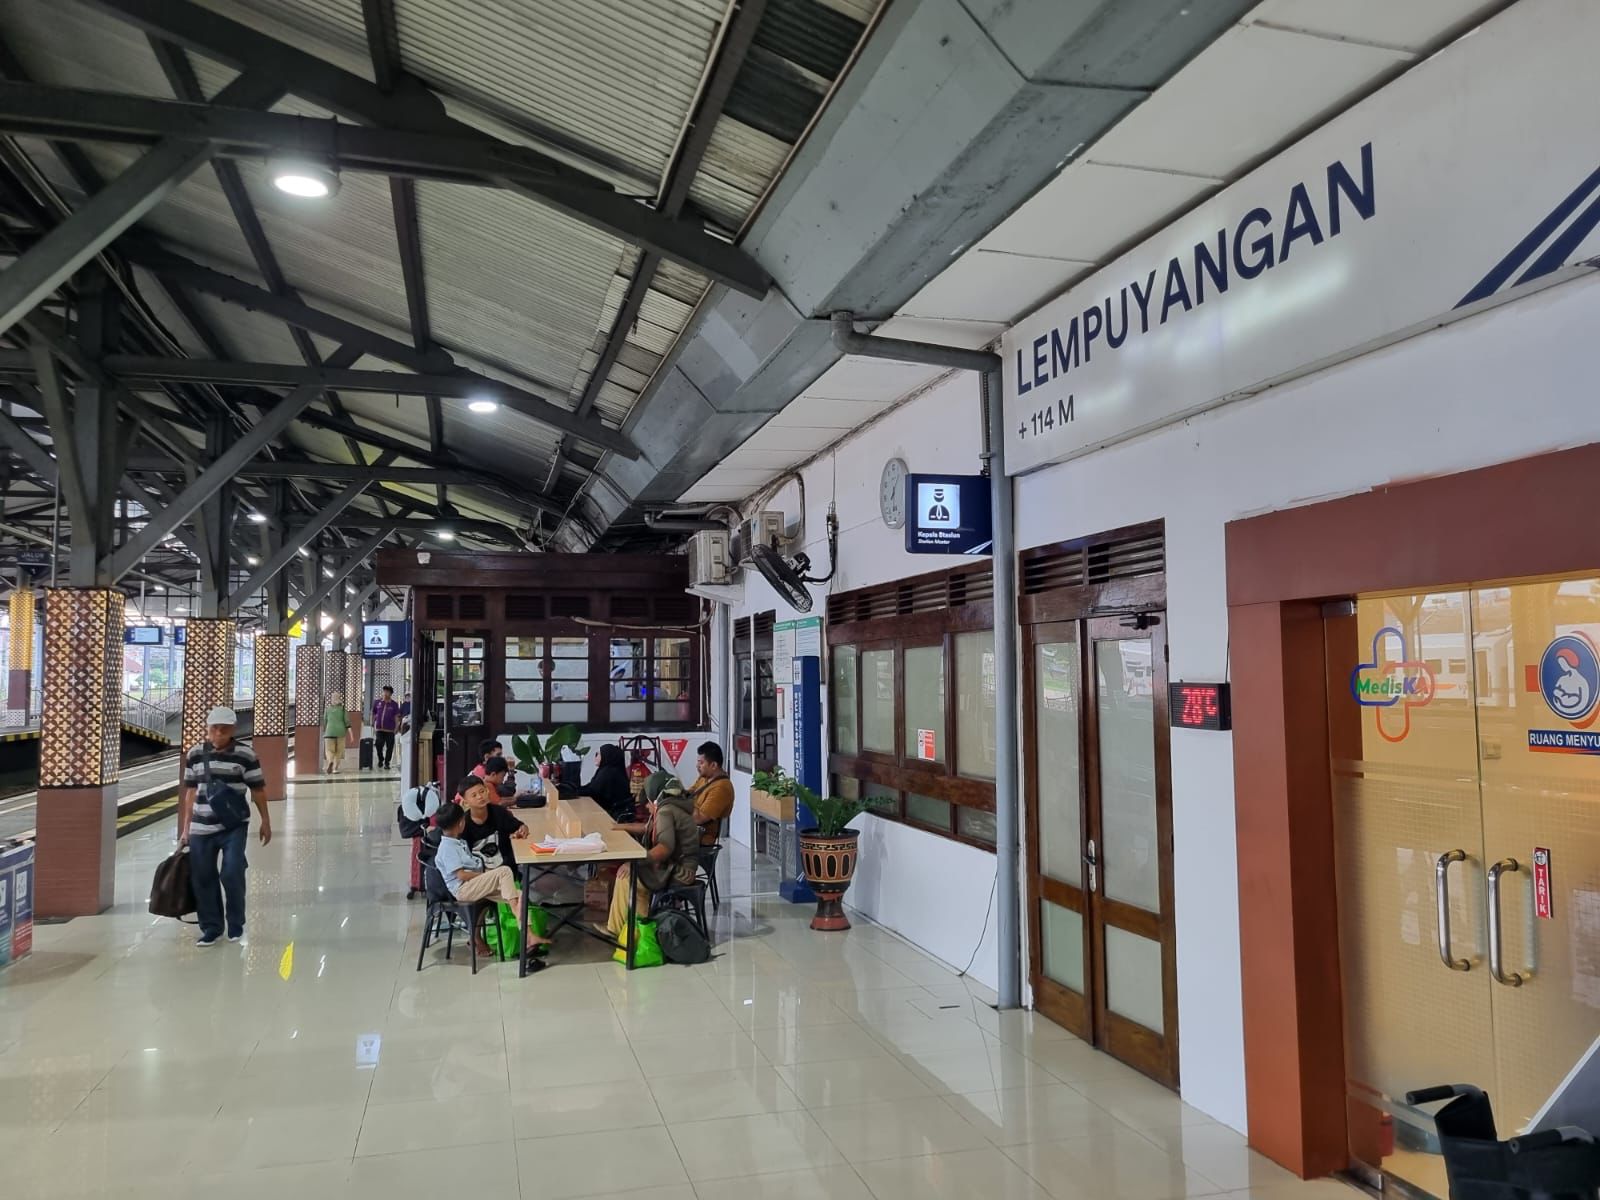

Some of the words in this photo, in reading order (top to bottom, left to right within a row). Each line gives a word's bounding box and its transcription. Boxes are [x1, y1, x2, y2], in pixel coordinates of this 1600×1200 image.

[1016, 141, 1376, 396] LEMPUYANGAN
[1031, 406, 1055, 437] 114
[1058, 394, 1074, 427] M
[1356, 676, 1430, 696] MedisKA
[1529, 732, 1564, 746] RUANG
[1537, 868, 1547, 914] TARIK
